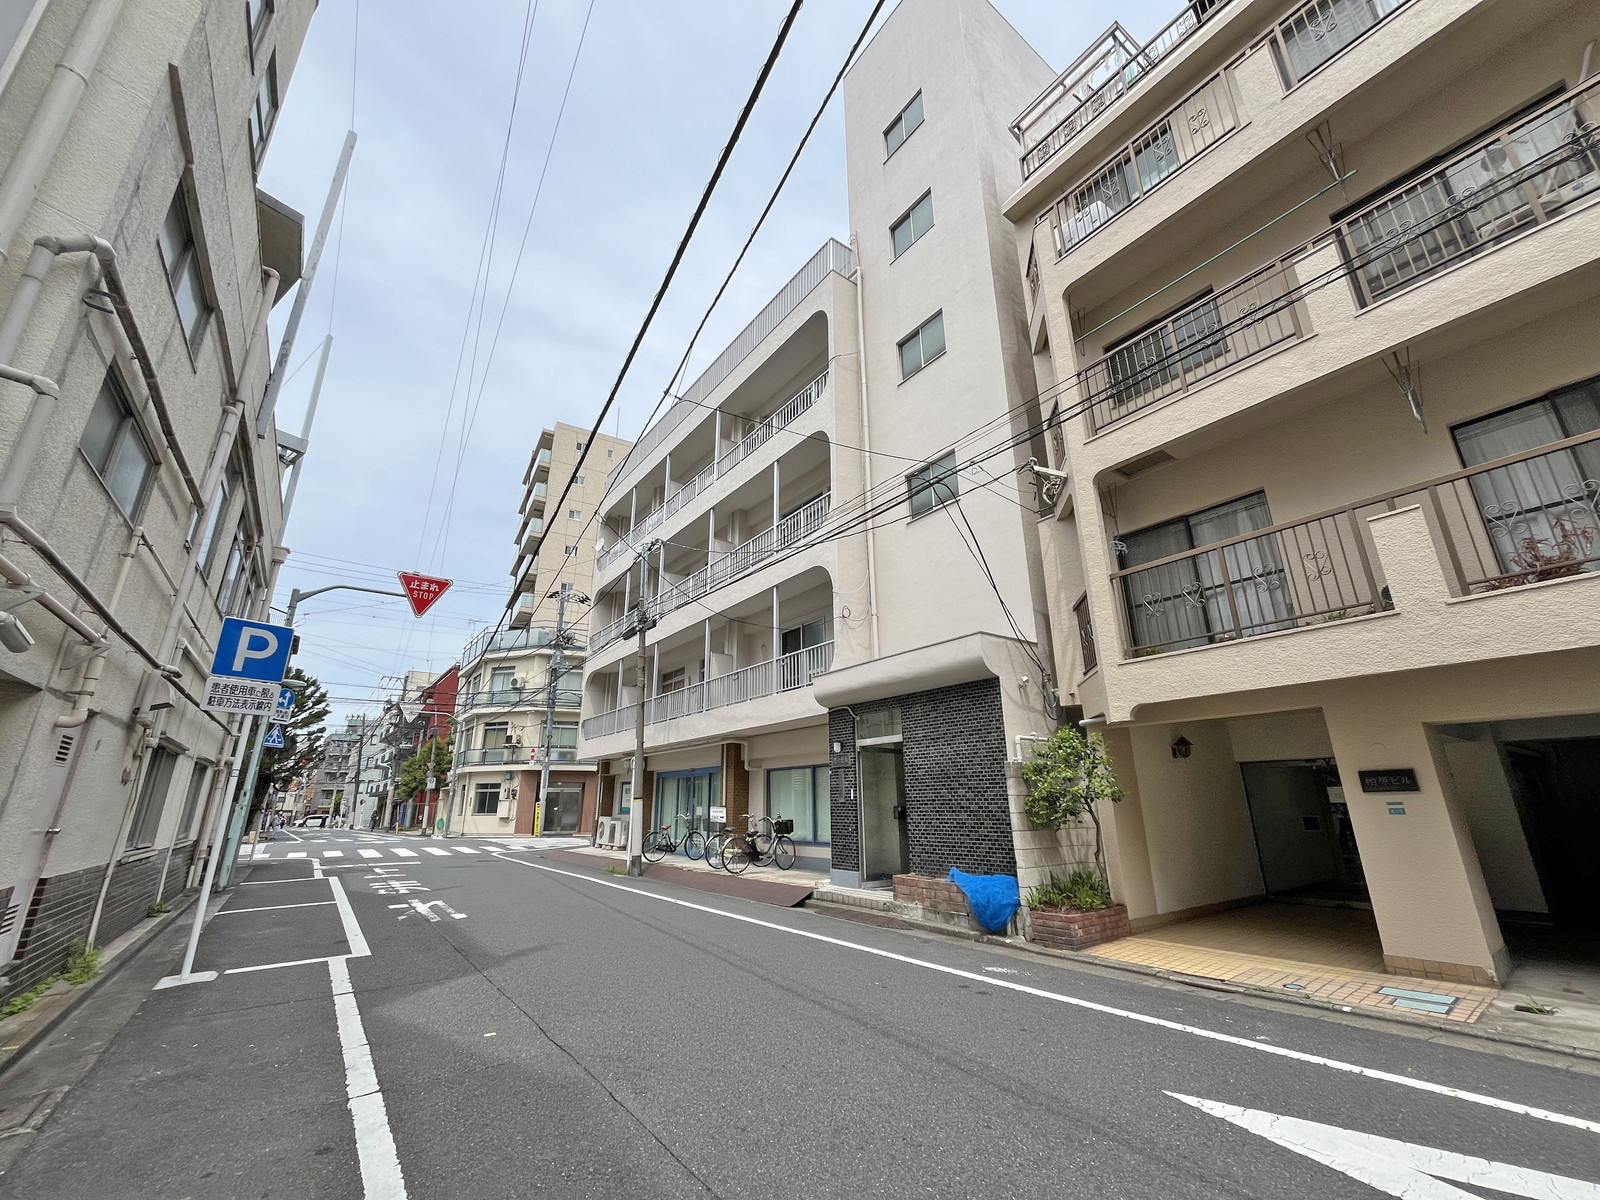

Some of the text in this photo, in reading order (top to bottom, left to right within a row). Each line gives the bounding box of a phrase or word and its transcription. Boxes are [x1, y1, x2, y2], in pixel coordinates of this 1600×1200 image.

[409, 580, 439, 592] 止まれ
[412, 590, 434, 600] STOP
[232, 626, 279, 672] P
[211, 682, 274, 699] 患者使用車に限る
[207, 696, 272, 712] 駐車方法表示線内
